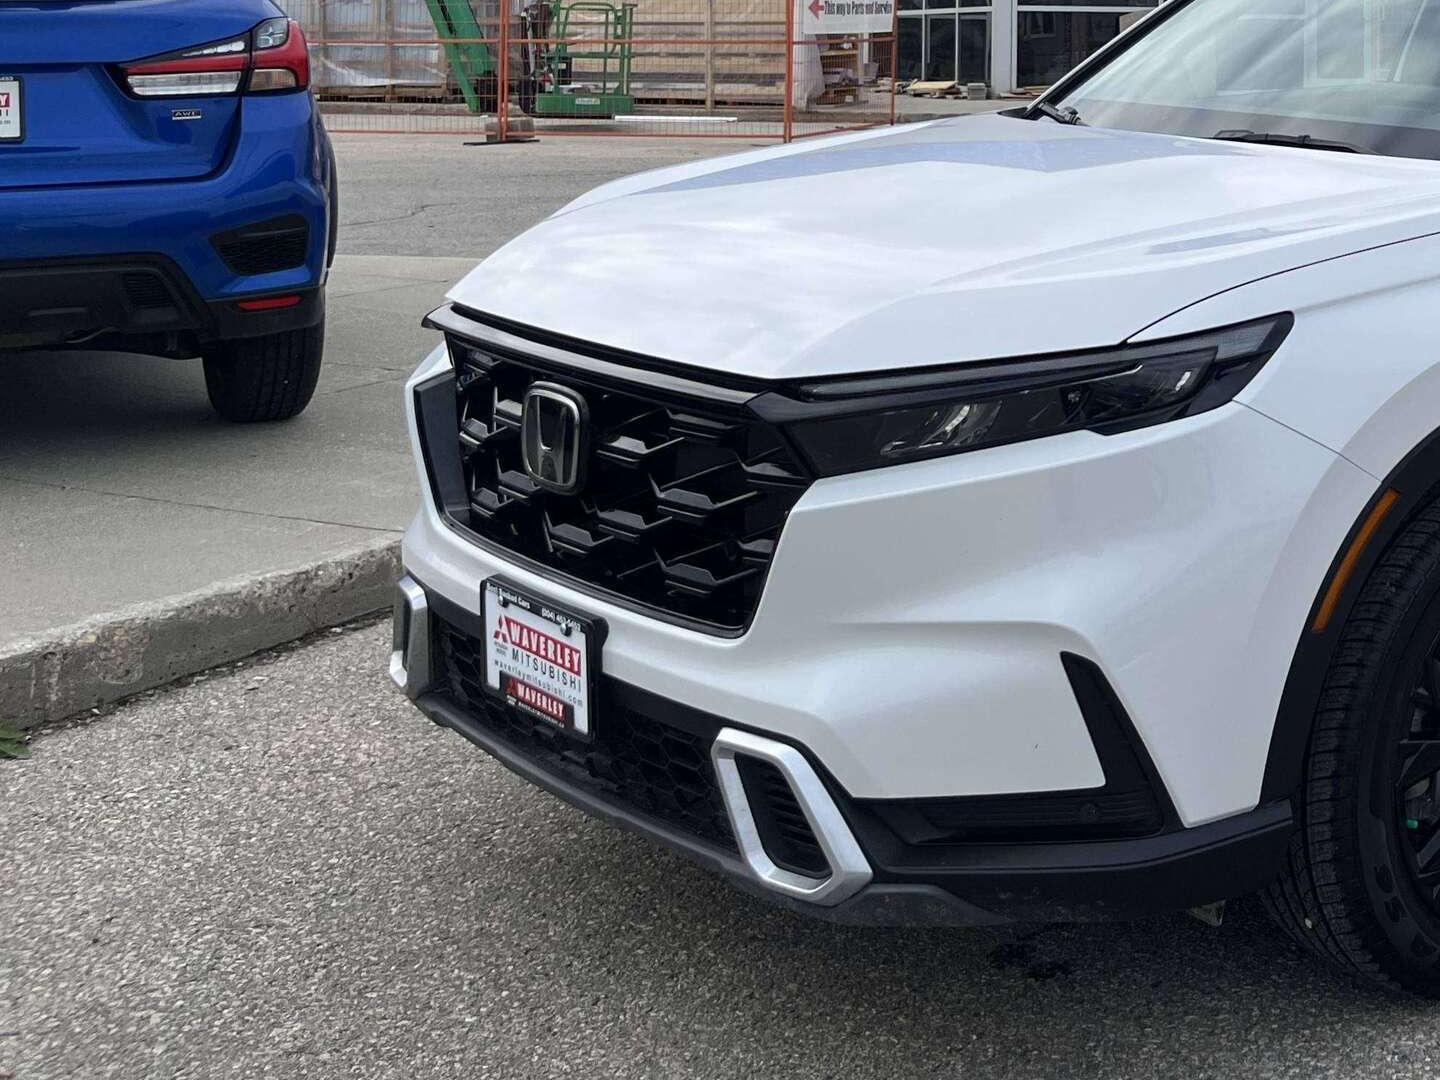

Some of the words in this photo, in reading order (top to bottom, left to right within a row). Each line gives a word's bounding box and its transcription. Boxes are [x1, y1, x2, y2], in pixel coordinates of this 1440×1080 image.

[510, 620, 581, 673] WAVERLEY
[511, 648, 582, 693] MITSUBISHI
[517, 682, 564, 717] WAVERLEY
